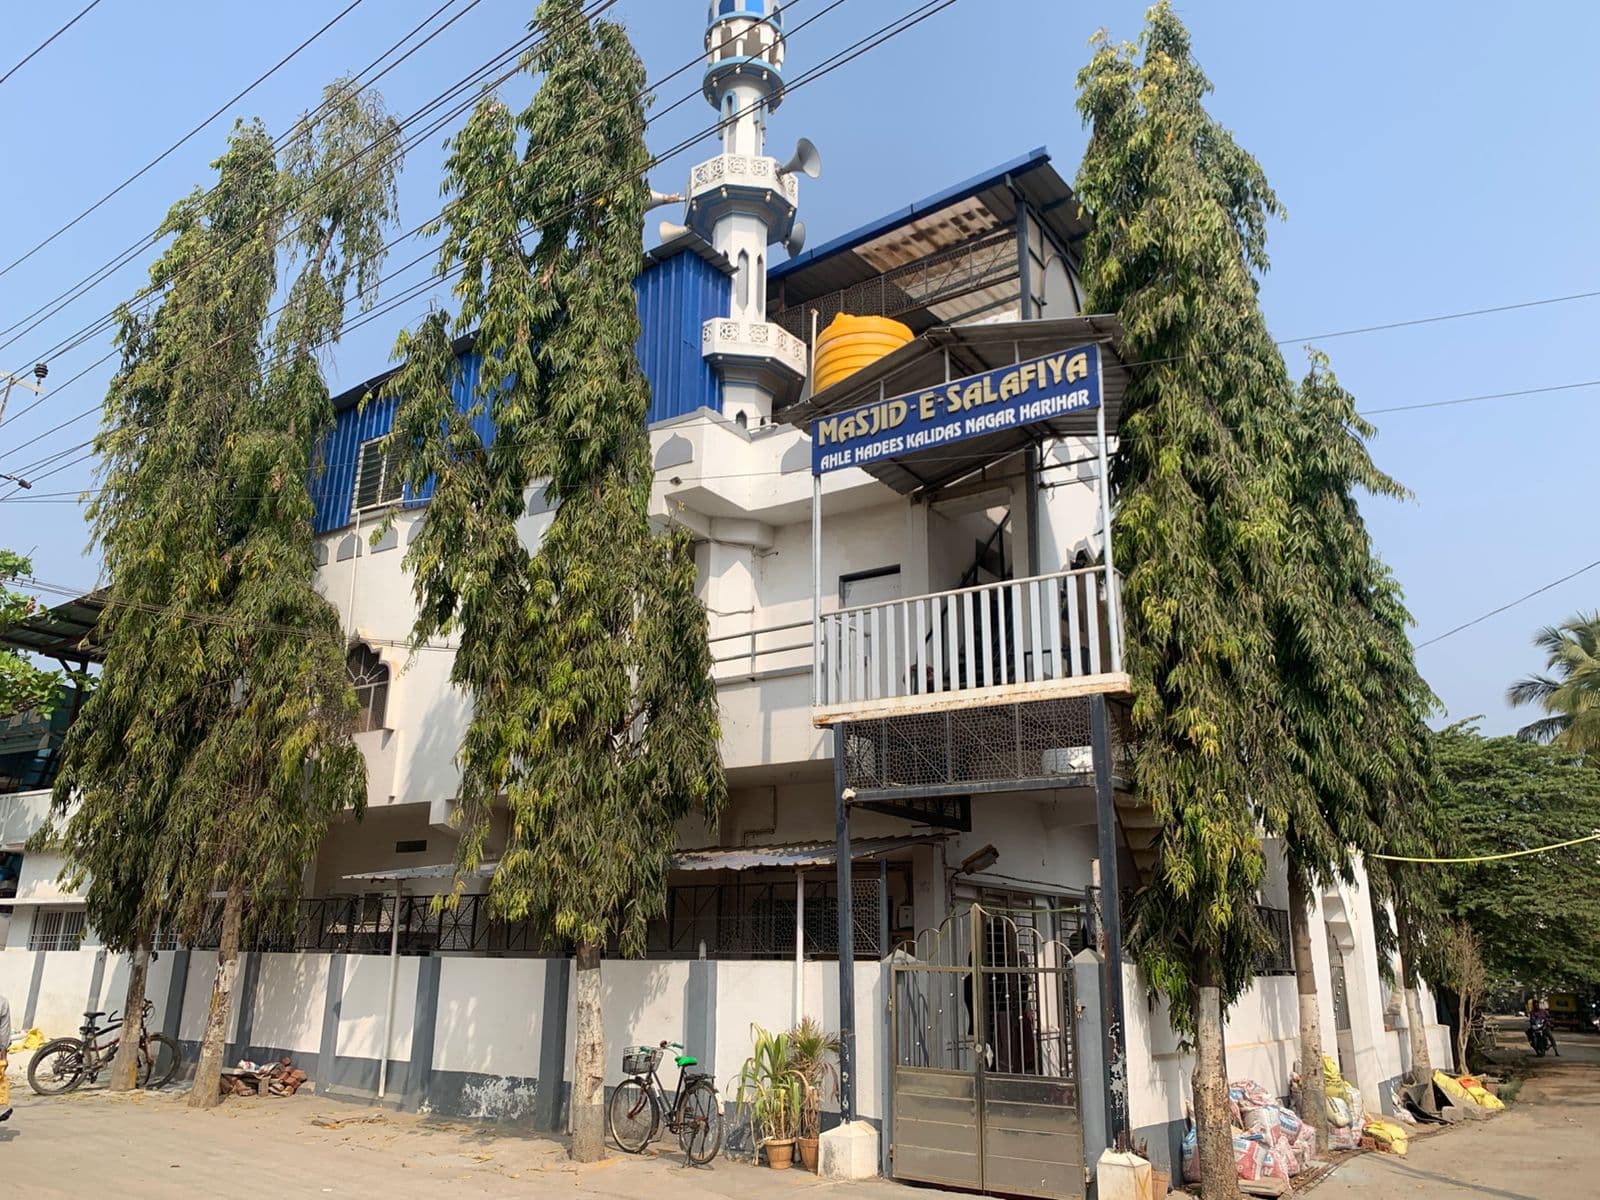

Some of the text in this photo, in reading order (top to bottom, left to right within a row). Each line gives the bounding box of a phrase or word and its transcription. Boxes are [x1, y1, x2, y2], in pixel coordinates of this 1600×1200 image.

[821, 389, 1090, 470] AHLE HADEES KALIDAS NAGAR HARIHAR
